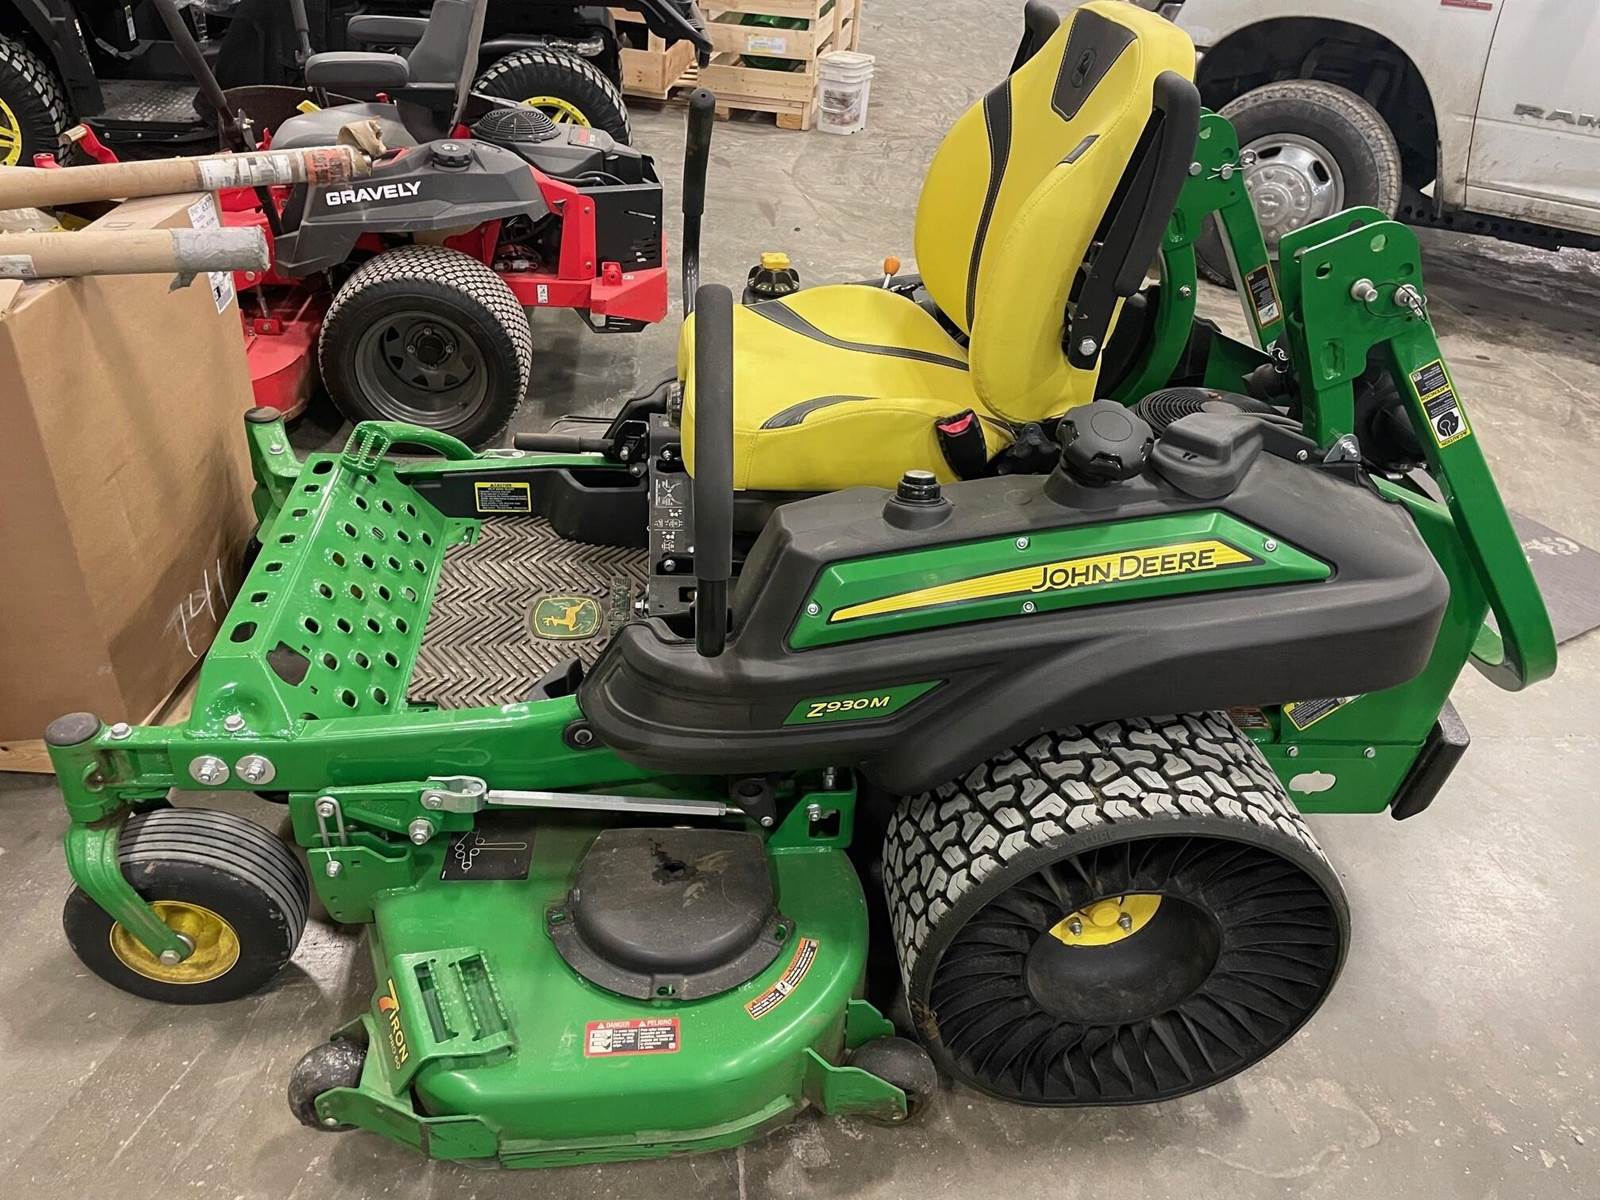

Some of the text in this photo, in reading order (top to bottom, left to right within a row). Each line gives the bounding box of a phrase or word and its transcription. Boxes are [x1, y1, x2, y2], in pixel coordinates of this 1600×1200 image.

[1513, 103, 1600, 128] RAM
[326, 181, 421, 206] GRAVELY
[1031, 548, 1216, 590] JOHN DEERE
[806, 696, 890, 718] Z930M
[606, 1019, 673, 1029] DANGER PELIGRO
